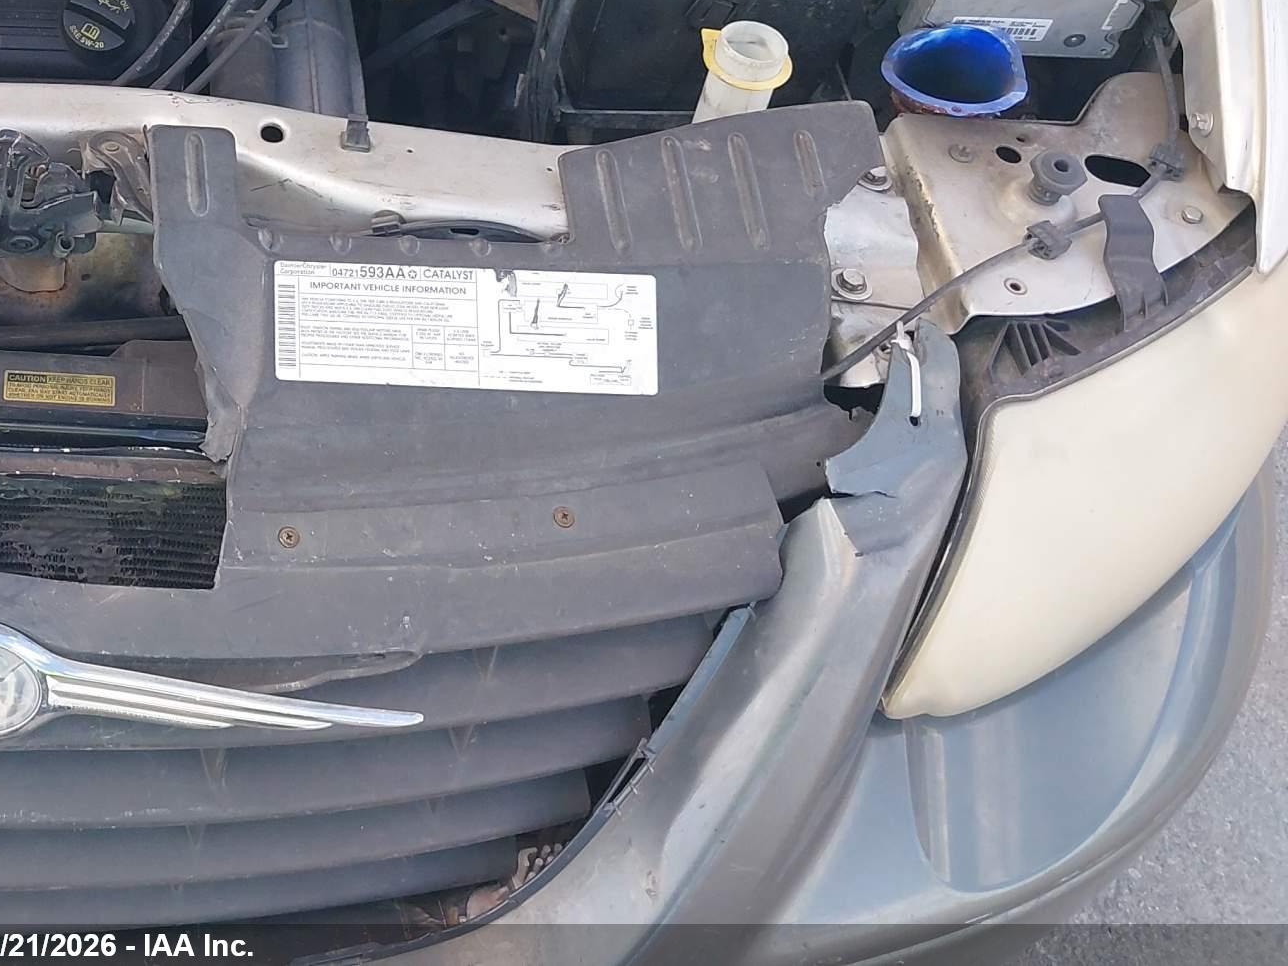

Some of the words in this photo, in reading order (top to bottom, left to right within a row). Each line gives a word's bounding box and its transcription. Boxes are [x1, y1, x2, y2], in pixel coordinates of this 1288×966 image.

[79, 37, 104, 49] 5W-20
[280, 267, 315, 275] Corporation
[280, 262, 327, 270] DaimlerChrysler
[332, 265, 406, 279] 04721593AA
[423, 268, 474, 281] CATALYST
[309, 281, 361, 291] IMPORTANT
[362, 283, 400, 293] VEHICLE
[402, 284, 467, 295] INFORMATION
[8, 374, 46, 383] CAUTION
